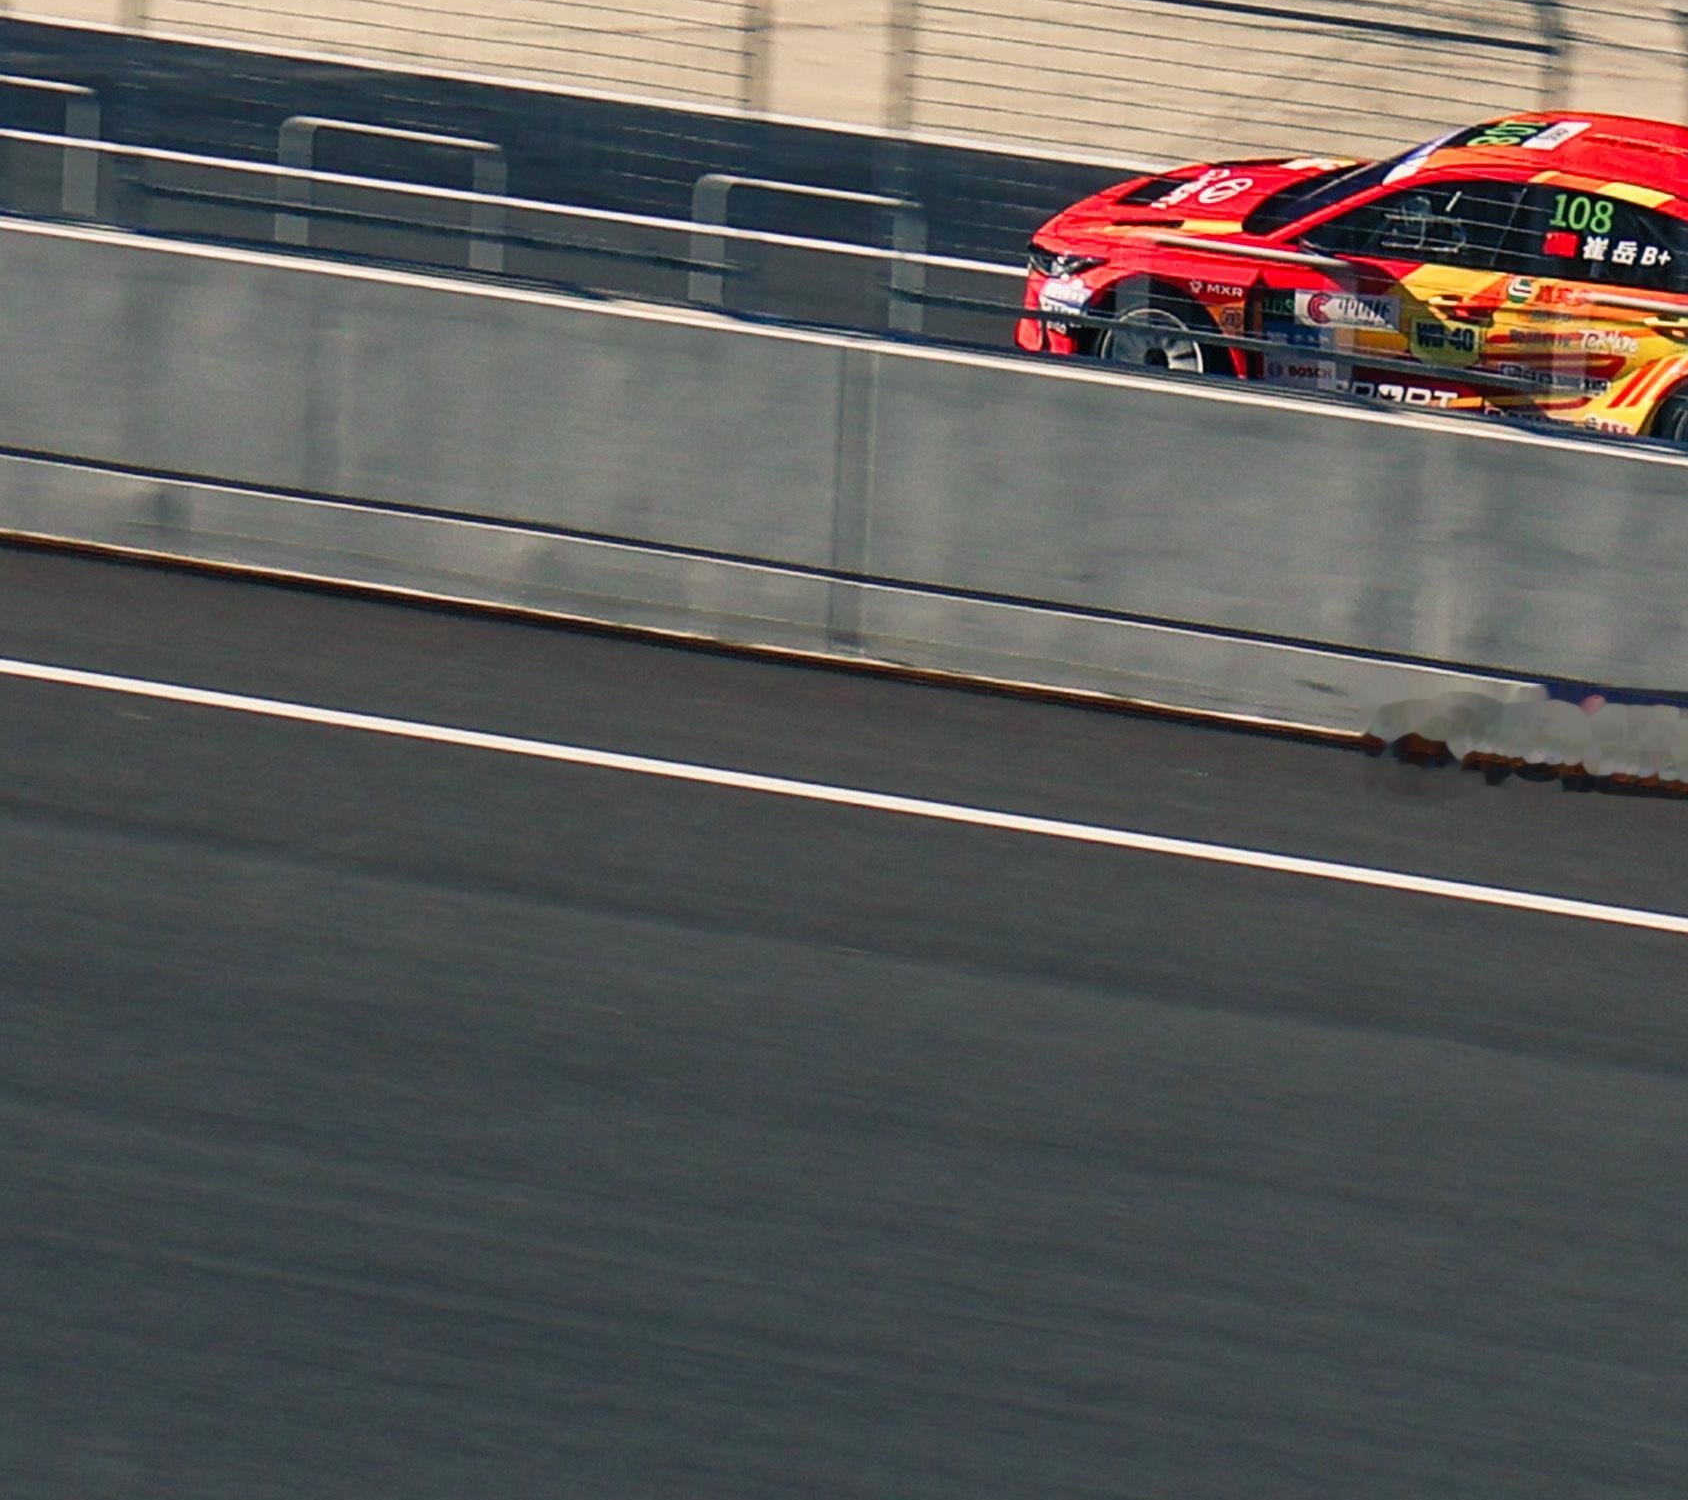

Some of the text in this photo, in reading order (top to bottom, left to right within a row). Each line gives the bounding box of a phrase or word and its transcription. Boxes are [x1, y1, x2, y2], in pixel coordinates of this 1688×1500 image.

[1466, 120, 1548, 147] 108
[1549, 193, 1615, 234] 108
[1640, 246, 1673, 267] B+
[1206, 282, 1244, 298] MXR
[1415, 321, 1475, 352] WD-40
[1287, 364, 1333, 379] BOSCH
